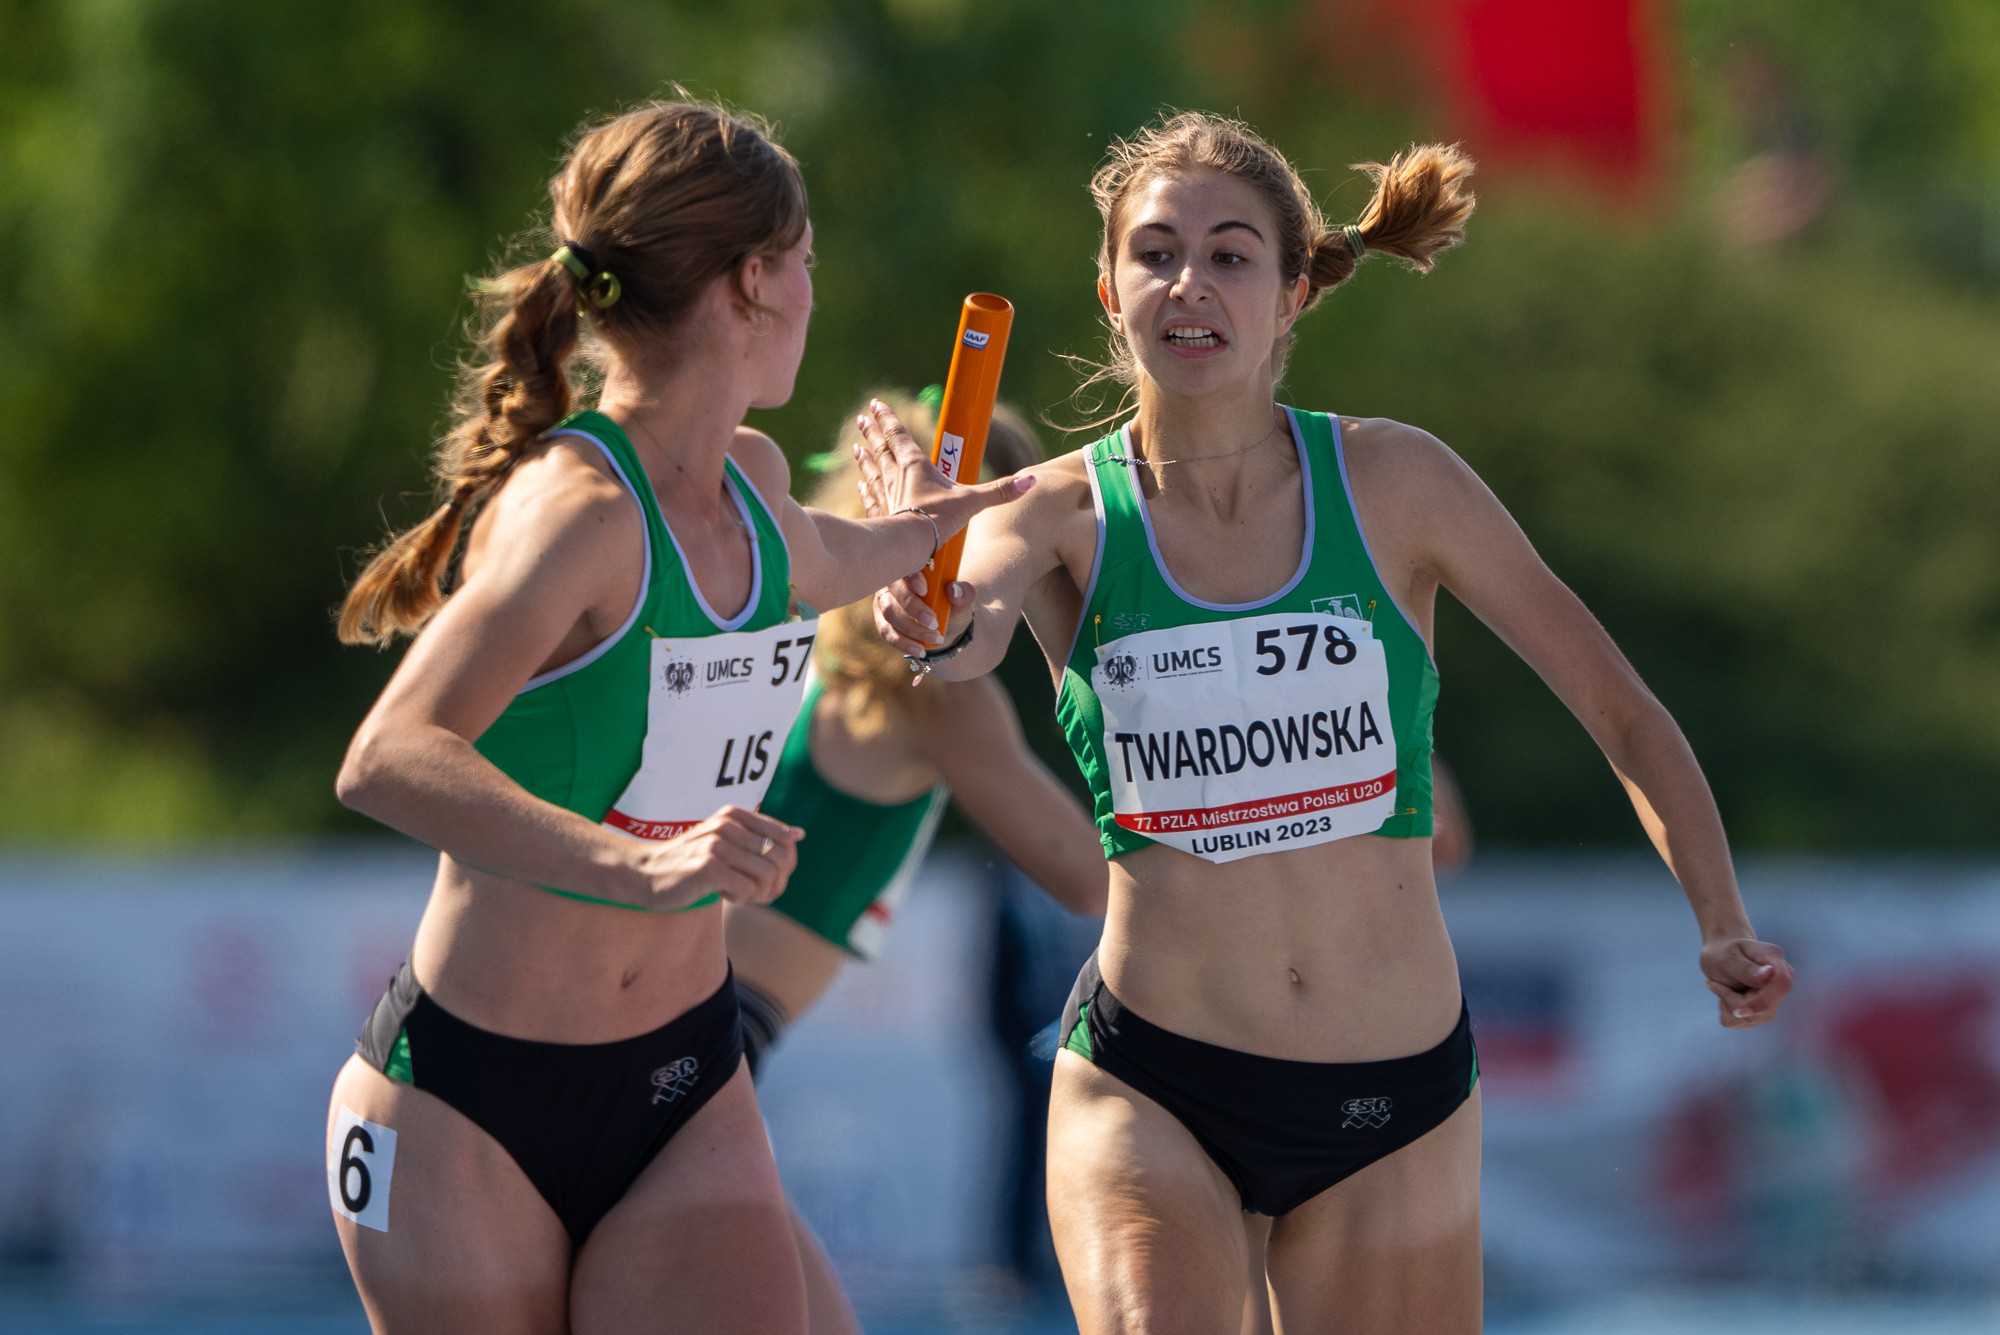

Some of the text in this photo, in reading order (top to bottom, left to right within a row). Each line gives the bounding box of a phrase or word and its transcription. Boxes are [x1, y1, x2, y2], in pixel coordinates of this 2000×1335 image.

[706, 657, 754, 682] UMCS
[1152, 646, 1222, 673] UMCS
[1256, 624, 1357, 676] 578
[715, 730, 774, 788] LIS
[1115, 701, 1383, 783] TWARDOWSKA
[626, 820, 648, 837] 77.
[650, 825, 683, 839] PZLA
[1133, 781, 1383, 830] 77. PZLA Mistrzostwa Polski U20
[1191, 816, 1332, 854] LUBLIN 2023
[339, 1125, 375, 1213] 6
